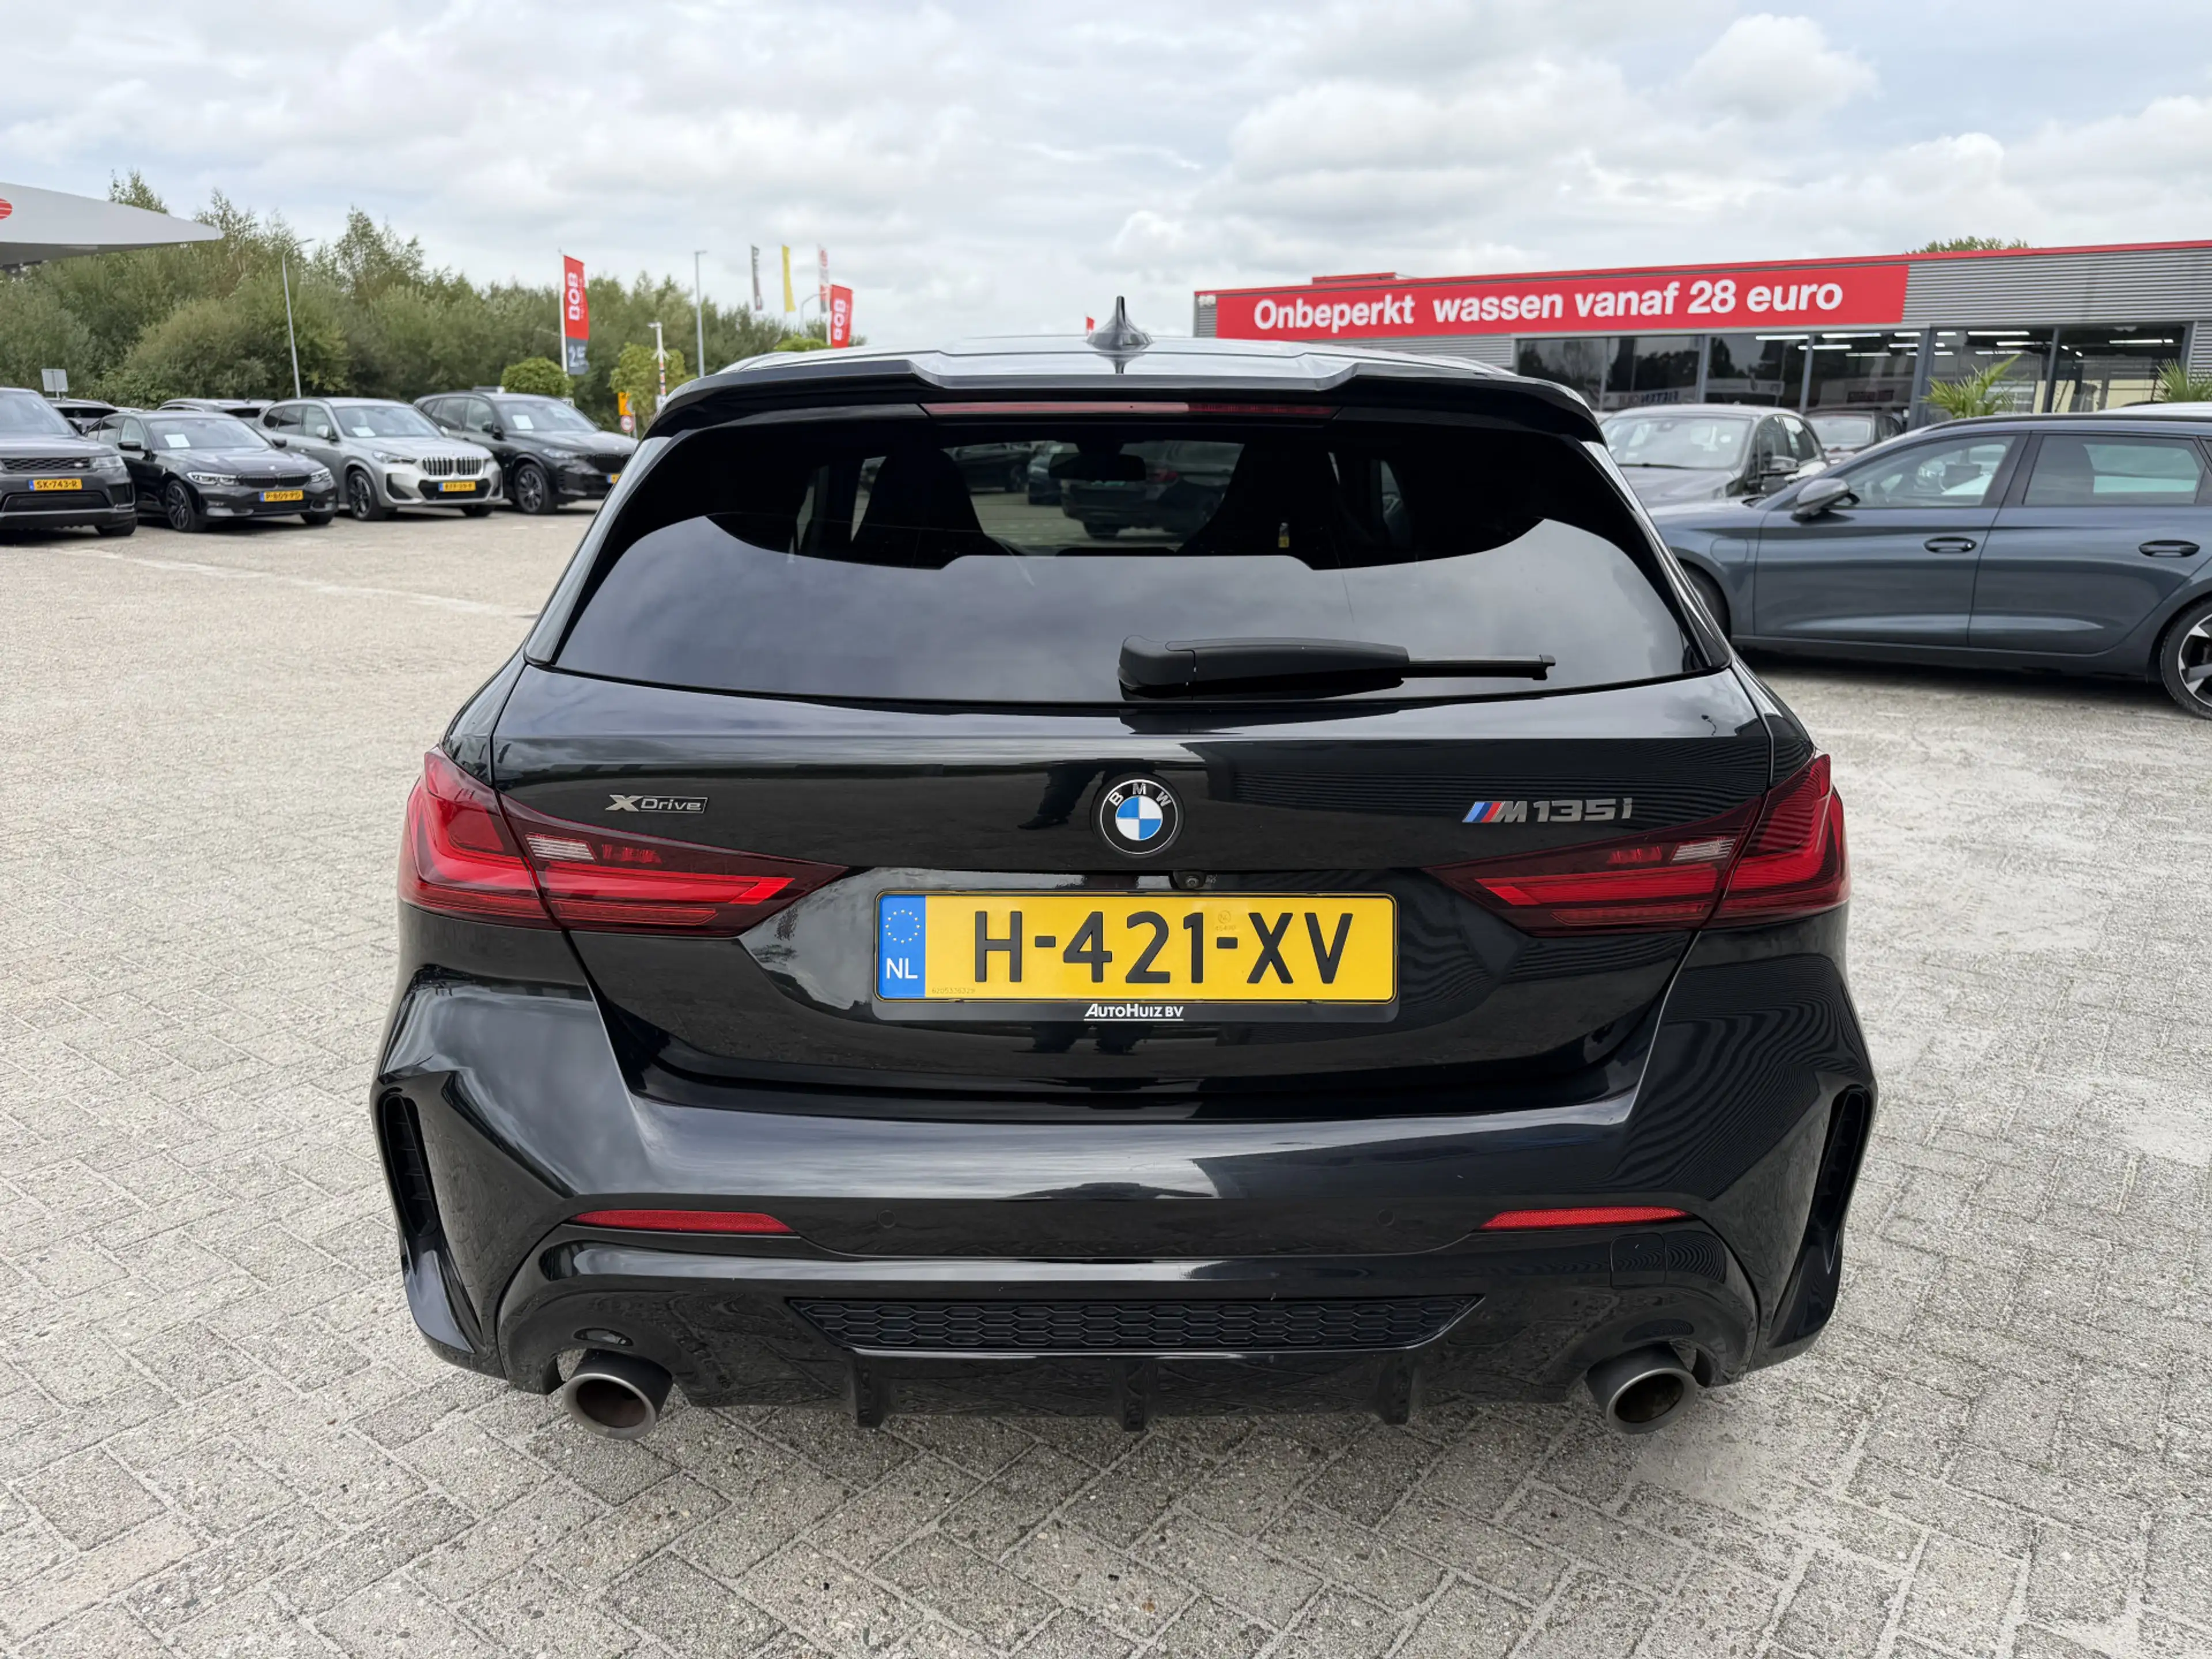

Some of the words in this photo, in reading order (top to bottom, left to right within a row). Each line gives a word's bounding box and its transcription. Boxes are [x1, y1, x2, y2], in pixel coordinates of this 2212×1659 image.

[1253, 293, 1415, 334] Onbeperkt
[1432, 287, 1563, 323] wassen
[1574, 281, 1680, 318] vanaf
[1687, 279, 1736, 314] 28
[1747, 282, 1843, 313] euro
[1108, 782, 1172, 807] BMW
[975, 910, 1354, 984] H-421-XV
[886, 957, 919, 979] NL
[1165, 1006, 1184, 1017] BV
